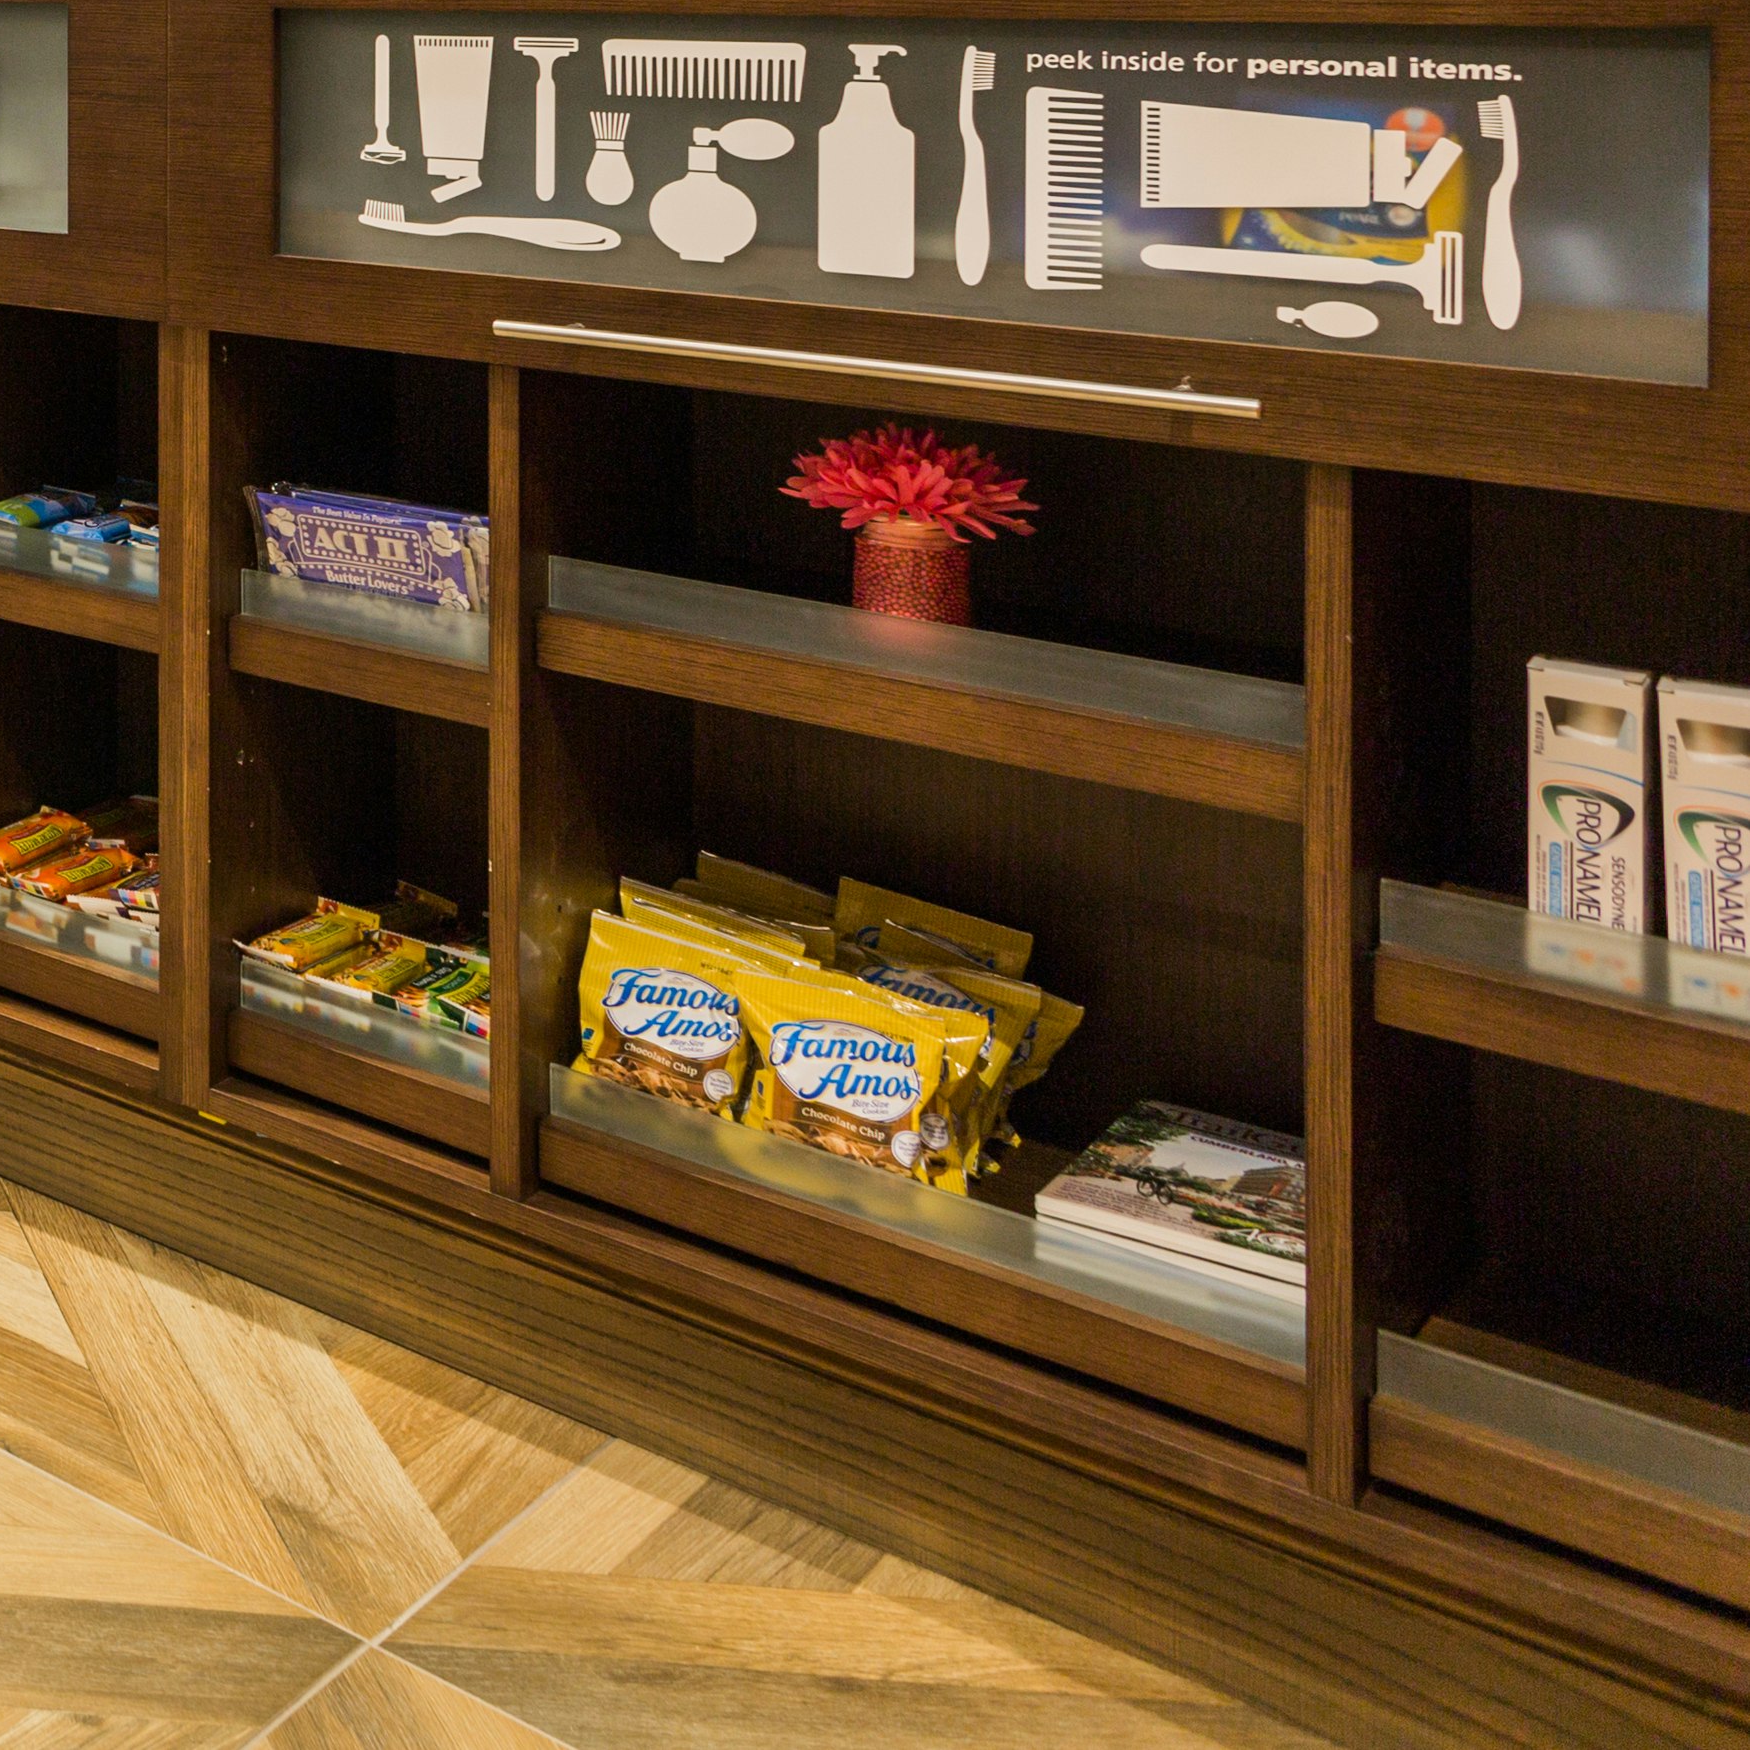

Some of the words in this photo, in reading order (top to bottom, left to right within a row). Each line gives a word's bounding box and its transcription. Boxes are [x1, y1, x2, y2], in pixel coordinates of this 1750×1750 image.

[1025, 49, 1094, 74] peek
[1101, 50, 1186, 72] inside
[1193, 51, 1239, 73] for
[1246, 55, 1398, 80] personal
[1409, 57, 1523, 82] items.
[313, 505, 326, 516] The
[326, 508, 343, 519] Best
[343, 511, 362, 521] Value
[313, 527, 370, 556] ACT
[373, 536, 411, 563] II
[325, 569, 366, 587] Butter
[1576, 799, 1602, 923] PRONAMEL
[1611, 856, 1626, 931] SENSODYNE
[1714, 824, 1746, 954] PRONAMEL
[601, 967, 740, 1016] Famous
[625, 1008, 740, 1043] Amos
[769, 1021, 917, 1067] Famous
[623, 1041, 673, 1069] Chocolate
[671, 1060, 698, 1078] Chip
[798, 1063, 921, 1100] Amos
[801, 1106, 859, 1132] Chocolate
[859, 1126, 887, 1142] Chip
